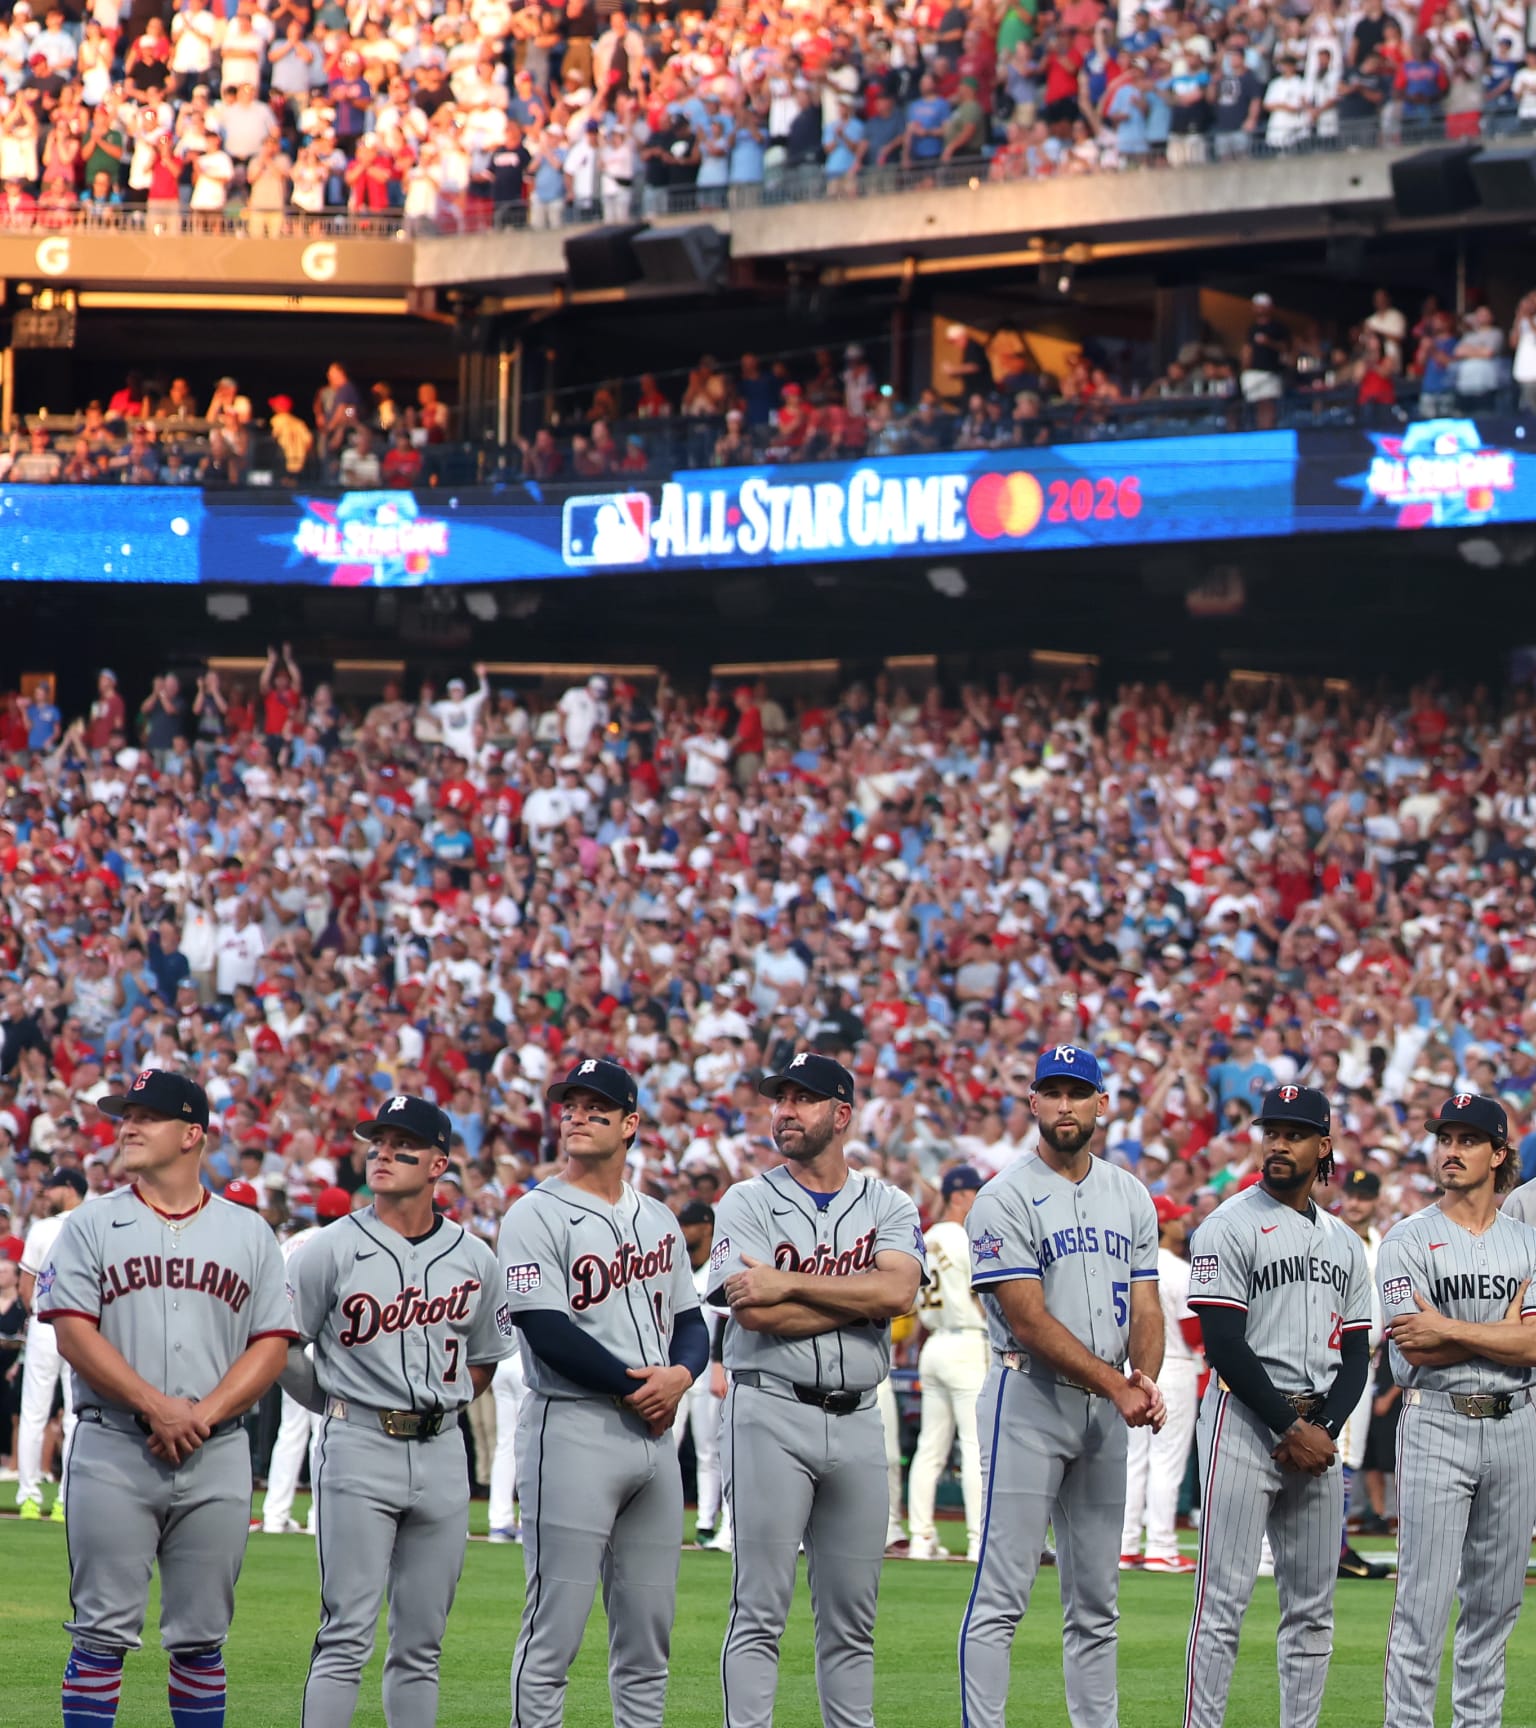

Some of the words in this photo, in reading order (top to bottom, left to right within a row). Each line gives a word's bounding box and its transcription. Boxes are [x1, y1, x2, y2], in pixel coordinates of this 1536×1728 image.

[36, 237, 70, 275] G
[301, 241, 337, 281] G
[848, 468, 967, 546] GAME
[1047, 476, 1142, 522] 2026
[1054, 1045, 1075, 1064] KC
[132, 1070, 152, 1091] C
[1353, 1169, 1366, 1183] P
[1104, 1229, 1131, 1265] CIT
[508, 1265, 537, 1276] USA
[570, 1233, 676, 1311] Detroit
[1192, 1269, 1217, 1280] 250
[1195, 1258, 1216, 1266] USA
[507, 1278, 539, 1290] 250
[1251, 1256, 1349, 1300] MINNESOT
[1384, 1278, 1408, 1291] USA
[1112, 1282, 1128, 1327] 5
[1385, 1291, 1411, 1304] 250
[340, 1279, 480, 1348] Detroit
[443, 1337, 459, 1383] 7
